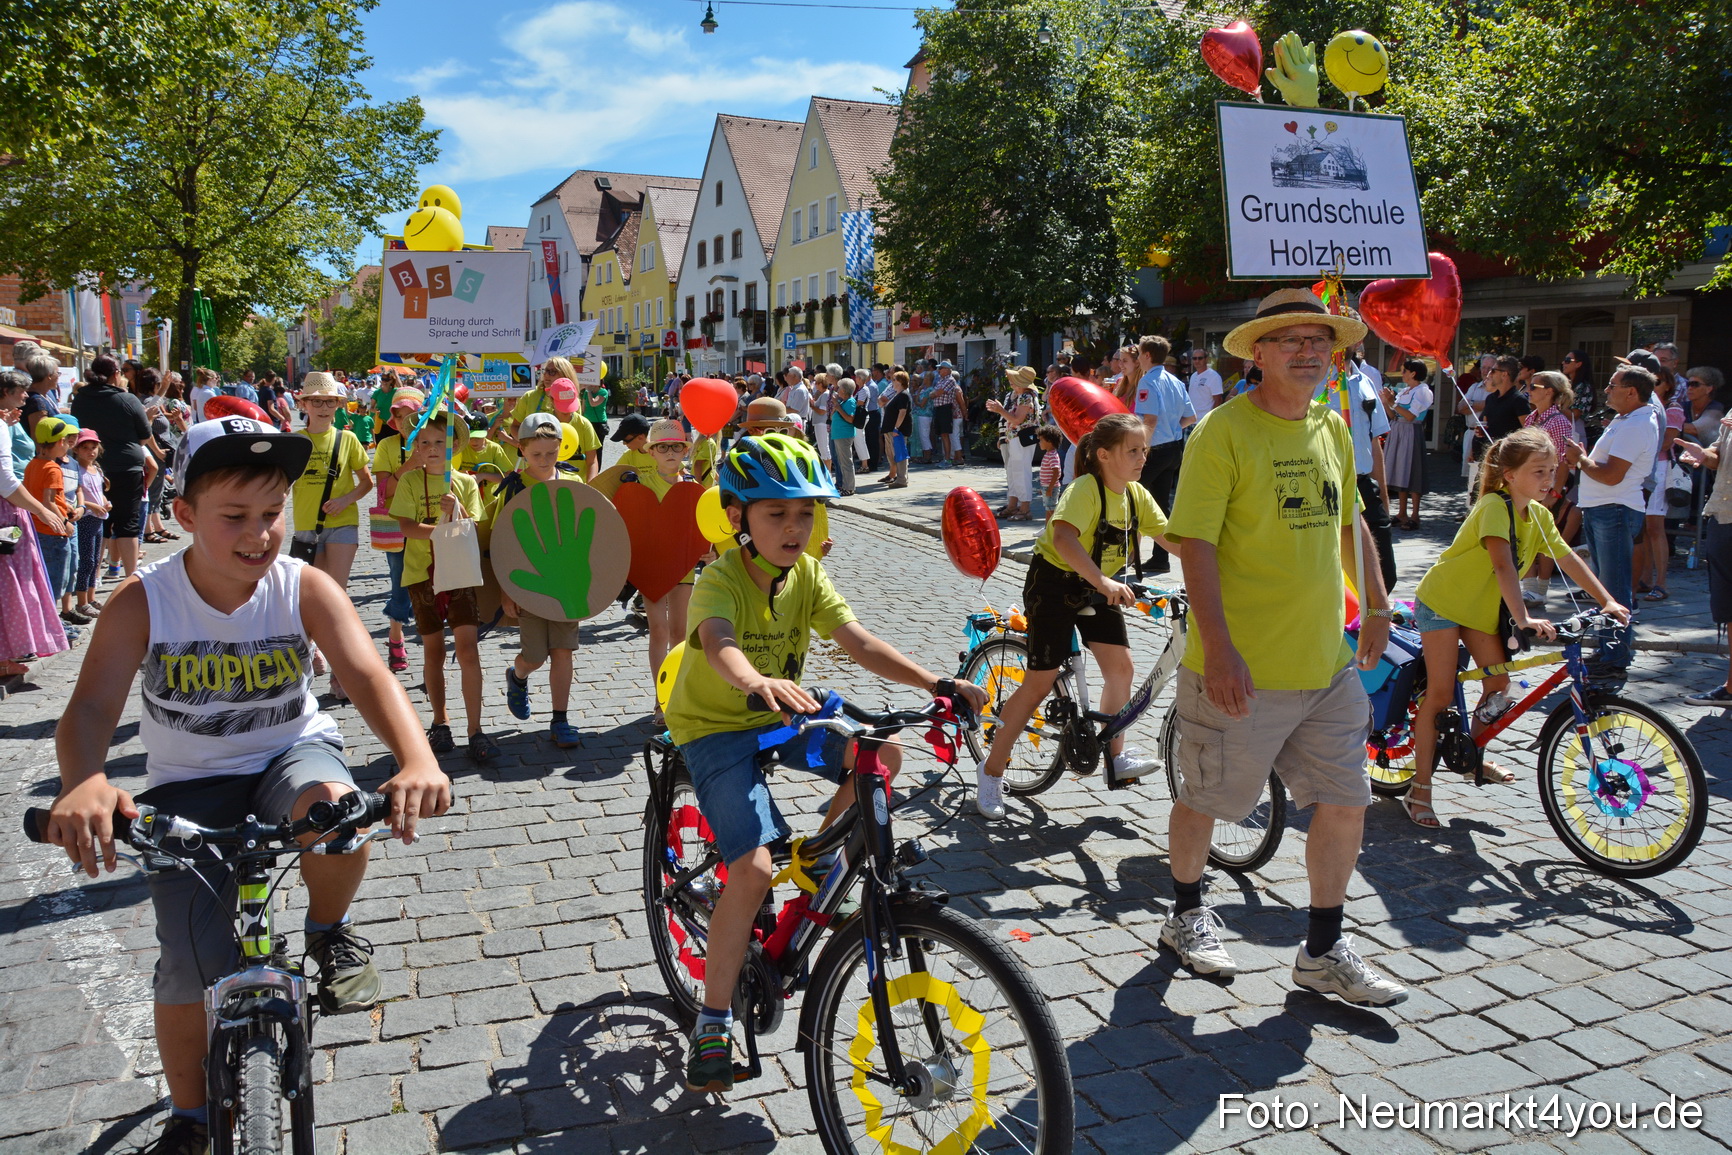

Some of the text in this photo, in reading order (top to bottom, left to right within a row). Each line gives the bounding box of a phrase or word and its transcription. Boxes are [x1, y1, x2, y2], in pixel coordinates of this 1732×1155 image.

[1240, 194, 1405, 225] Grundschule
[1269, 239, 1392, 266] Holzheim
[429, 316, 494, 328] Bildung durch
[428, 327, 521, 339] Sprache und Schrift
[786, 335, 794, 347] P
[464, 373, 509, 382] Fairtrade
[476, 382, 505, 391] School
[230, 419, 255, 433] 99
[1272, 456, 1314, 468] Grundschule
[1275, 470, 1307, 479] Holzheim
